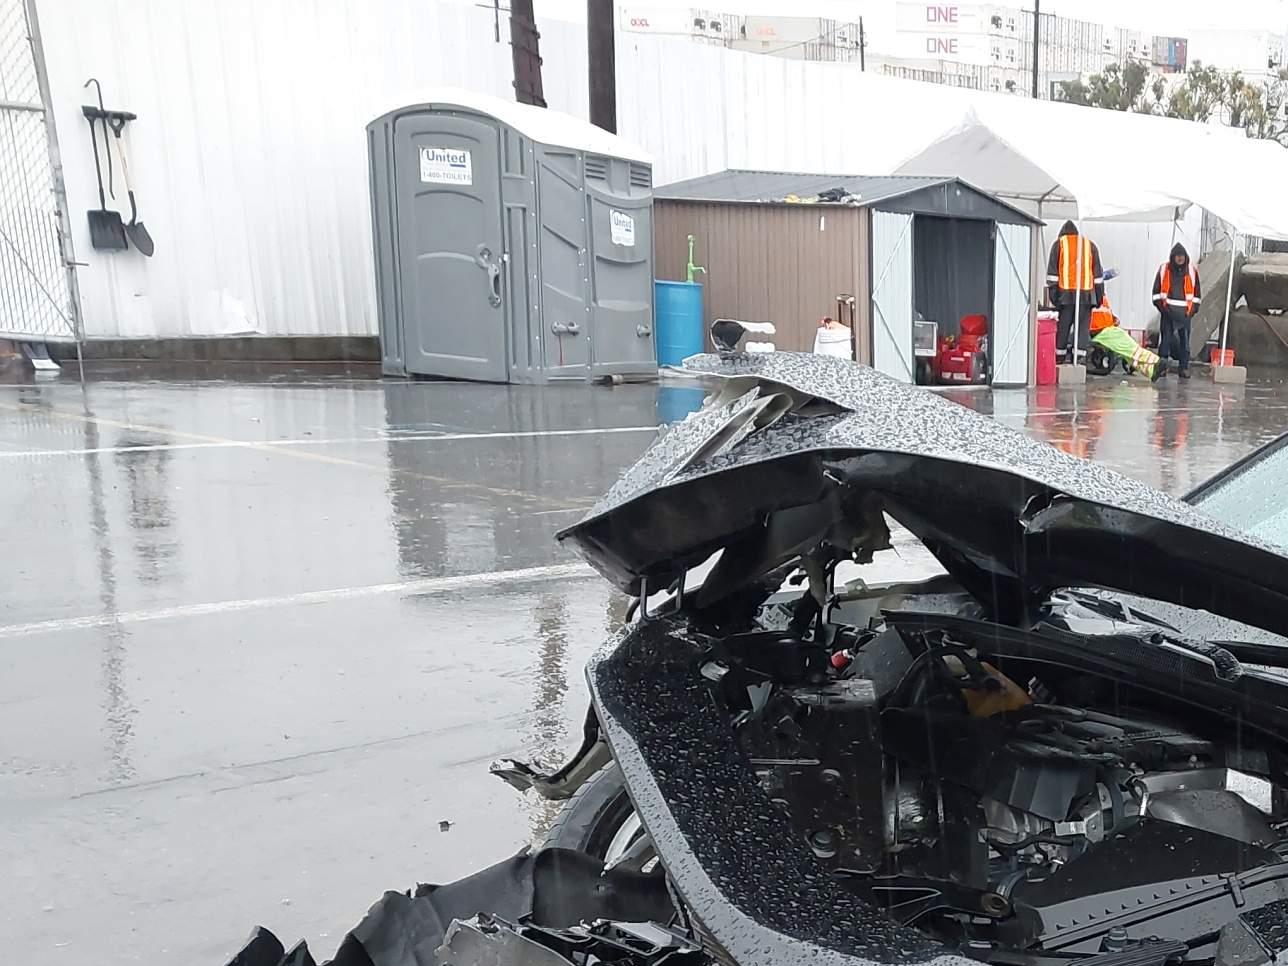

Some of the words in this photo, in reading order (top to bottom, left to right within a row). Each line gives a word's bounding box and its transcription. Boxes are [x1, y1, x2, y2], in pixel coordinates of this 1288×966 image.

[927, 6, 958, 23] ONE
[927, 37, 958, 54] ONE
[426, 149, 466, 163] United
